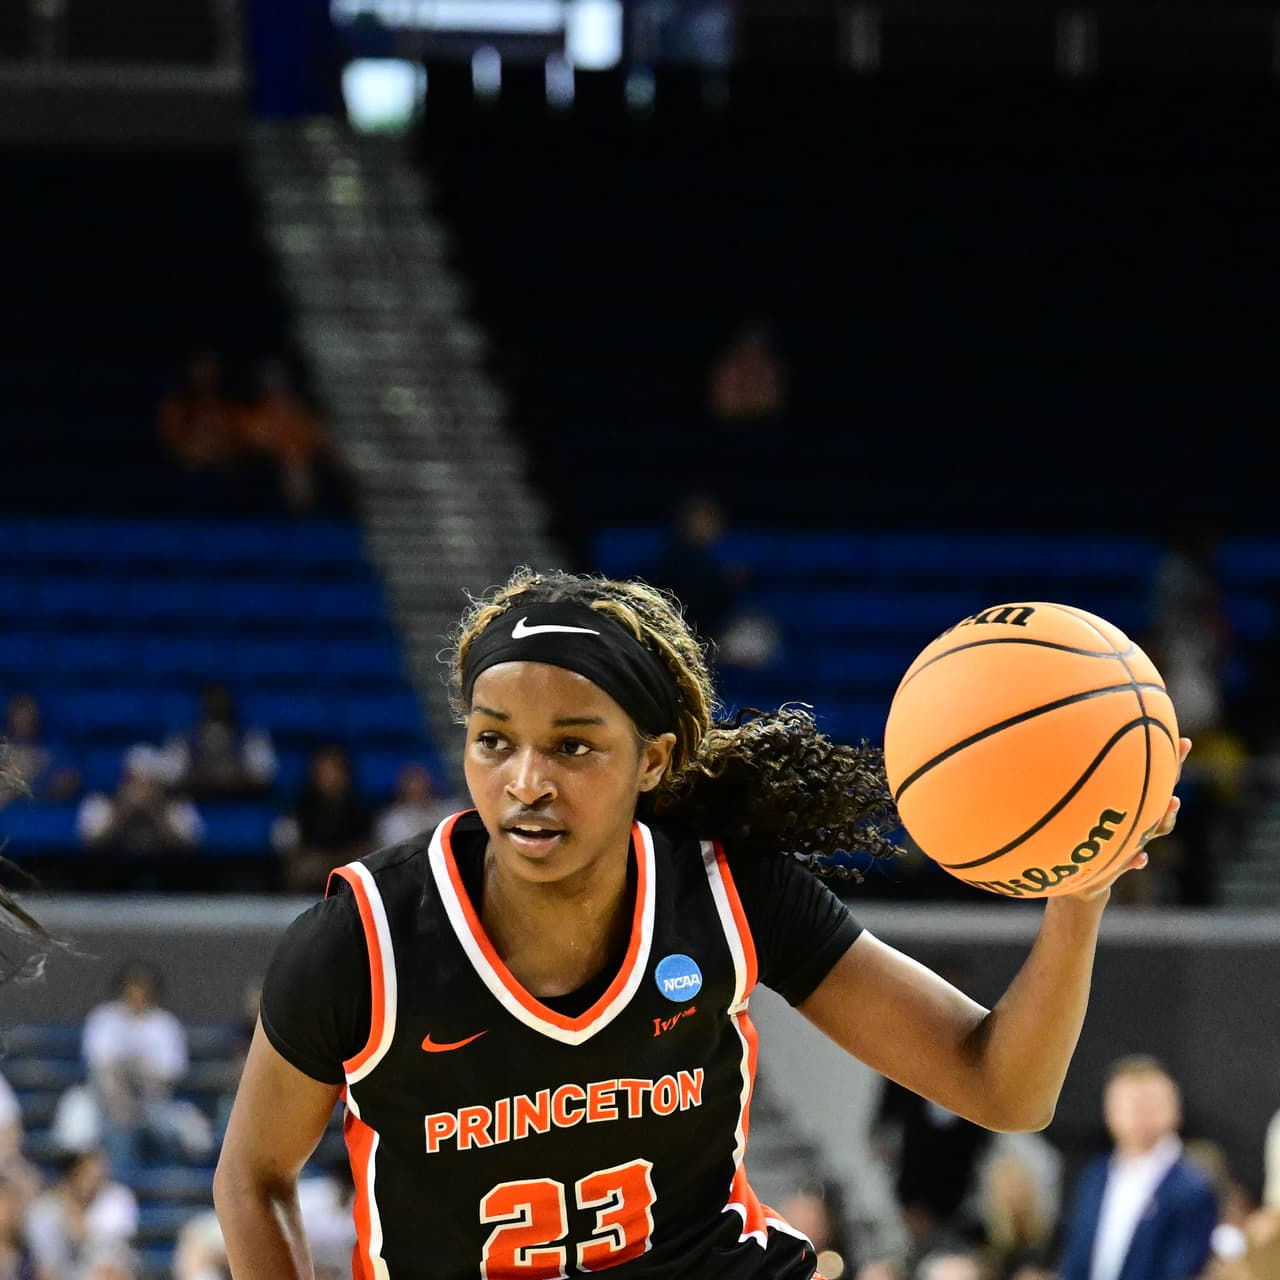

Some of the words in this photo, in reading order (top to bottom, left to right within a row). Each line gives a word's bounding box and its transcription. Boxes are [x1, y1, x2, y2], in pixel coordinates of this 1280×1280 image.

[663, 973, 700, 992] NCAA
[652, 1011, 682, 1037] Ivy
[425, 1068, 705, 1153] PRINCETON
